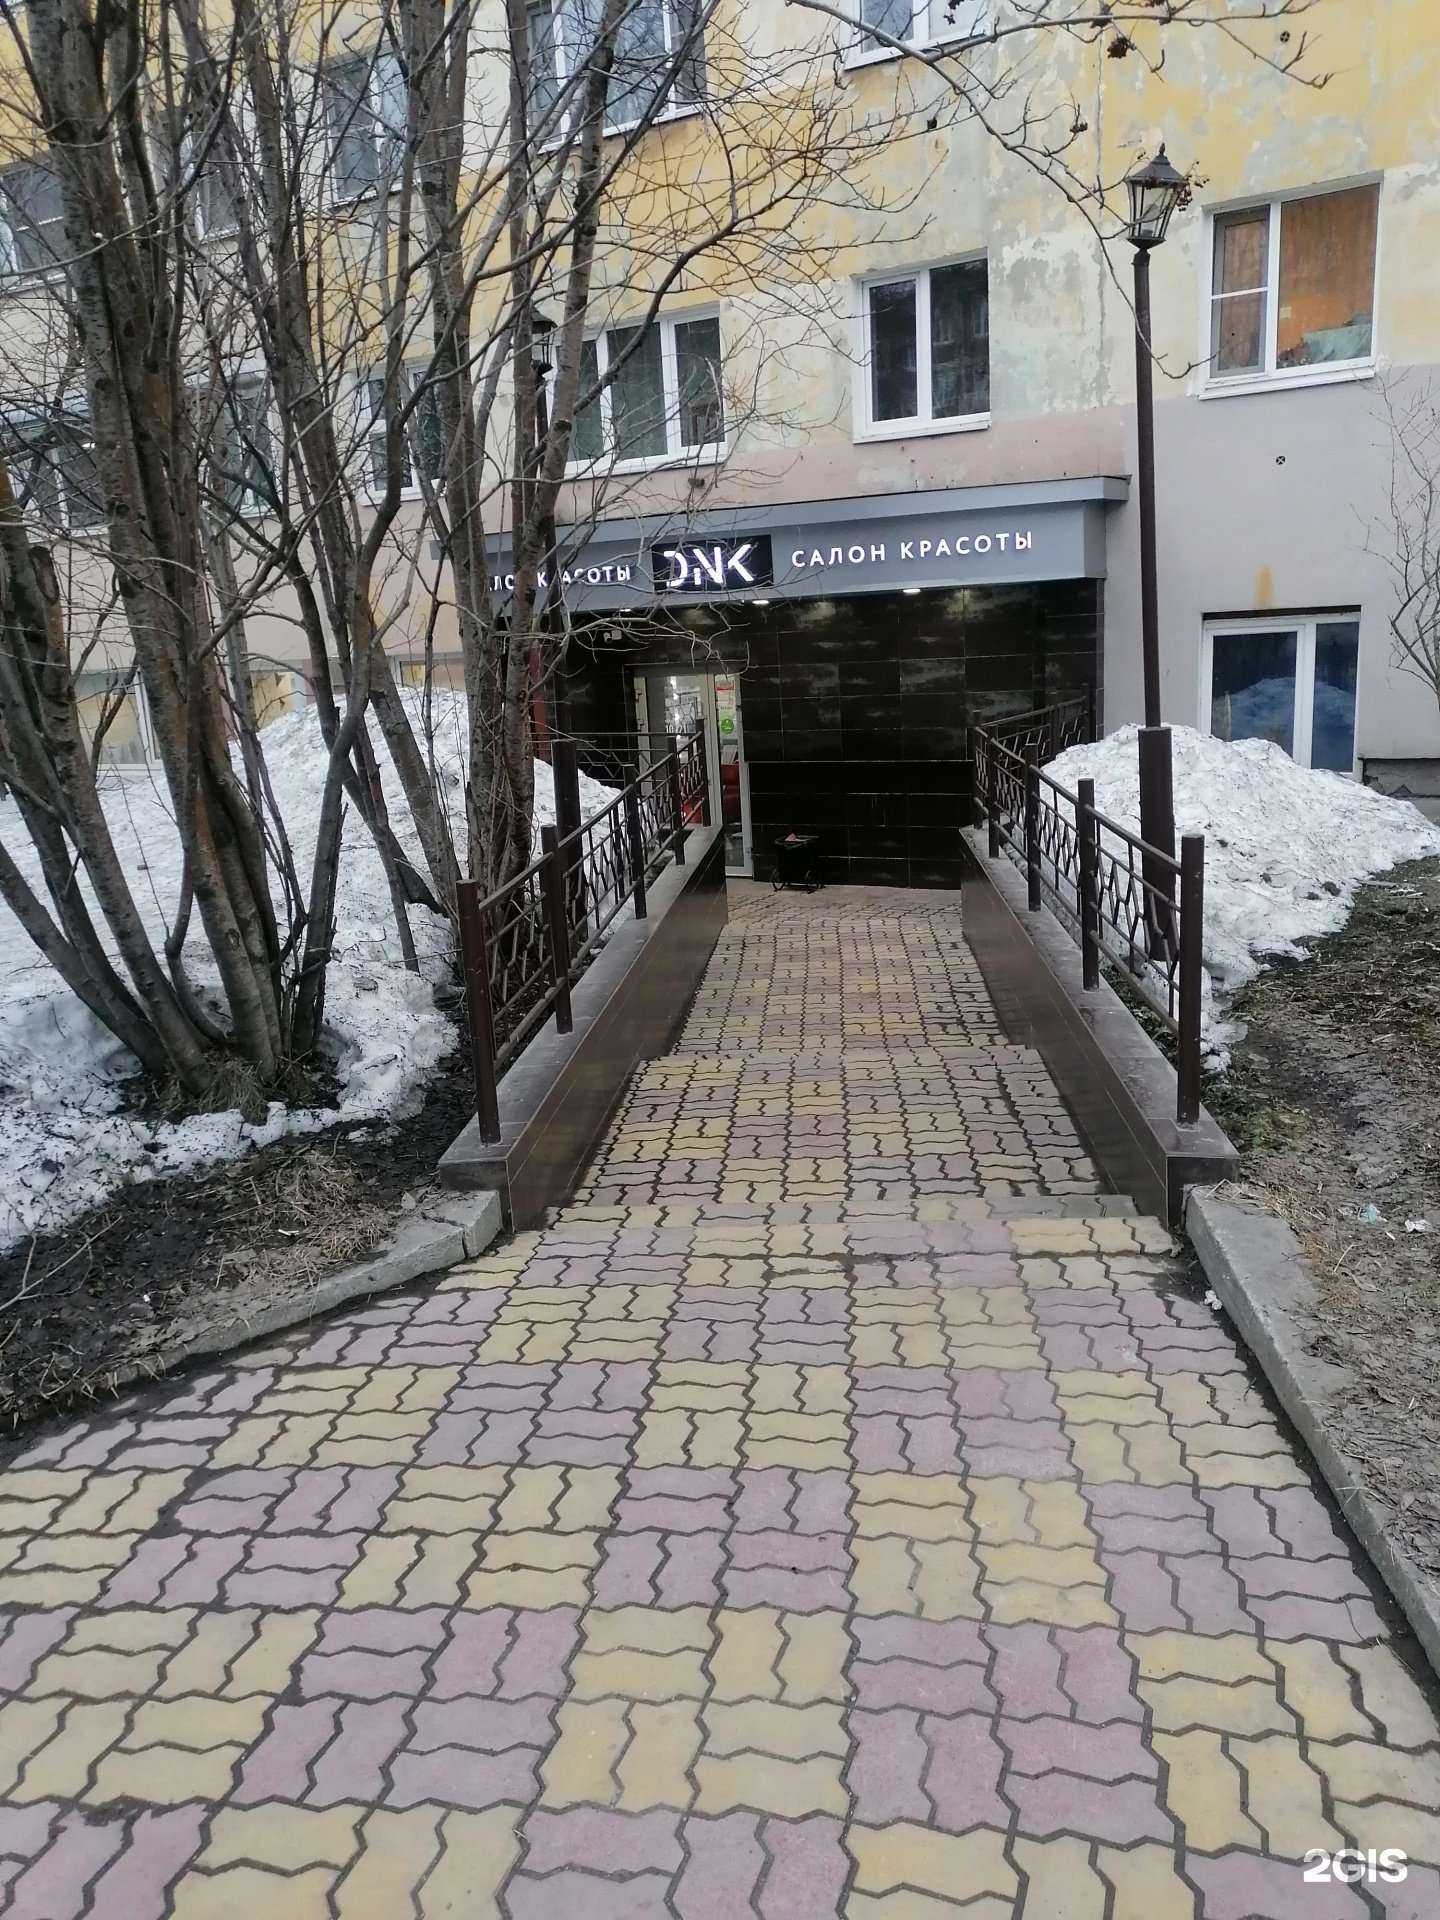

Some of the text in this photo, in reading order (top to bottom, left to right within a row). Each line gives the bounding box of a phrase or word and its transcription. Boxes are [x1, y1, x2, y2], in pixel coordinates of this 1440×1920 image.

[663, 543, 755, 587] DNK
[790, 531, 1033, 569] САЛОН КРАСОТЫ
[537, 565, 631, 588] КАСОТЫ
